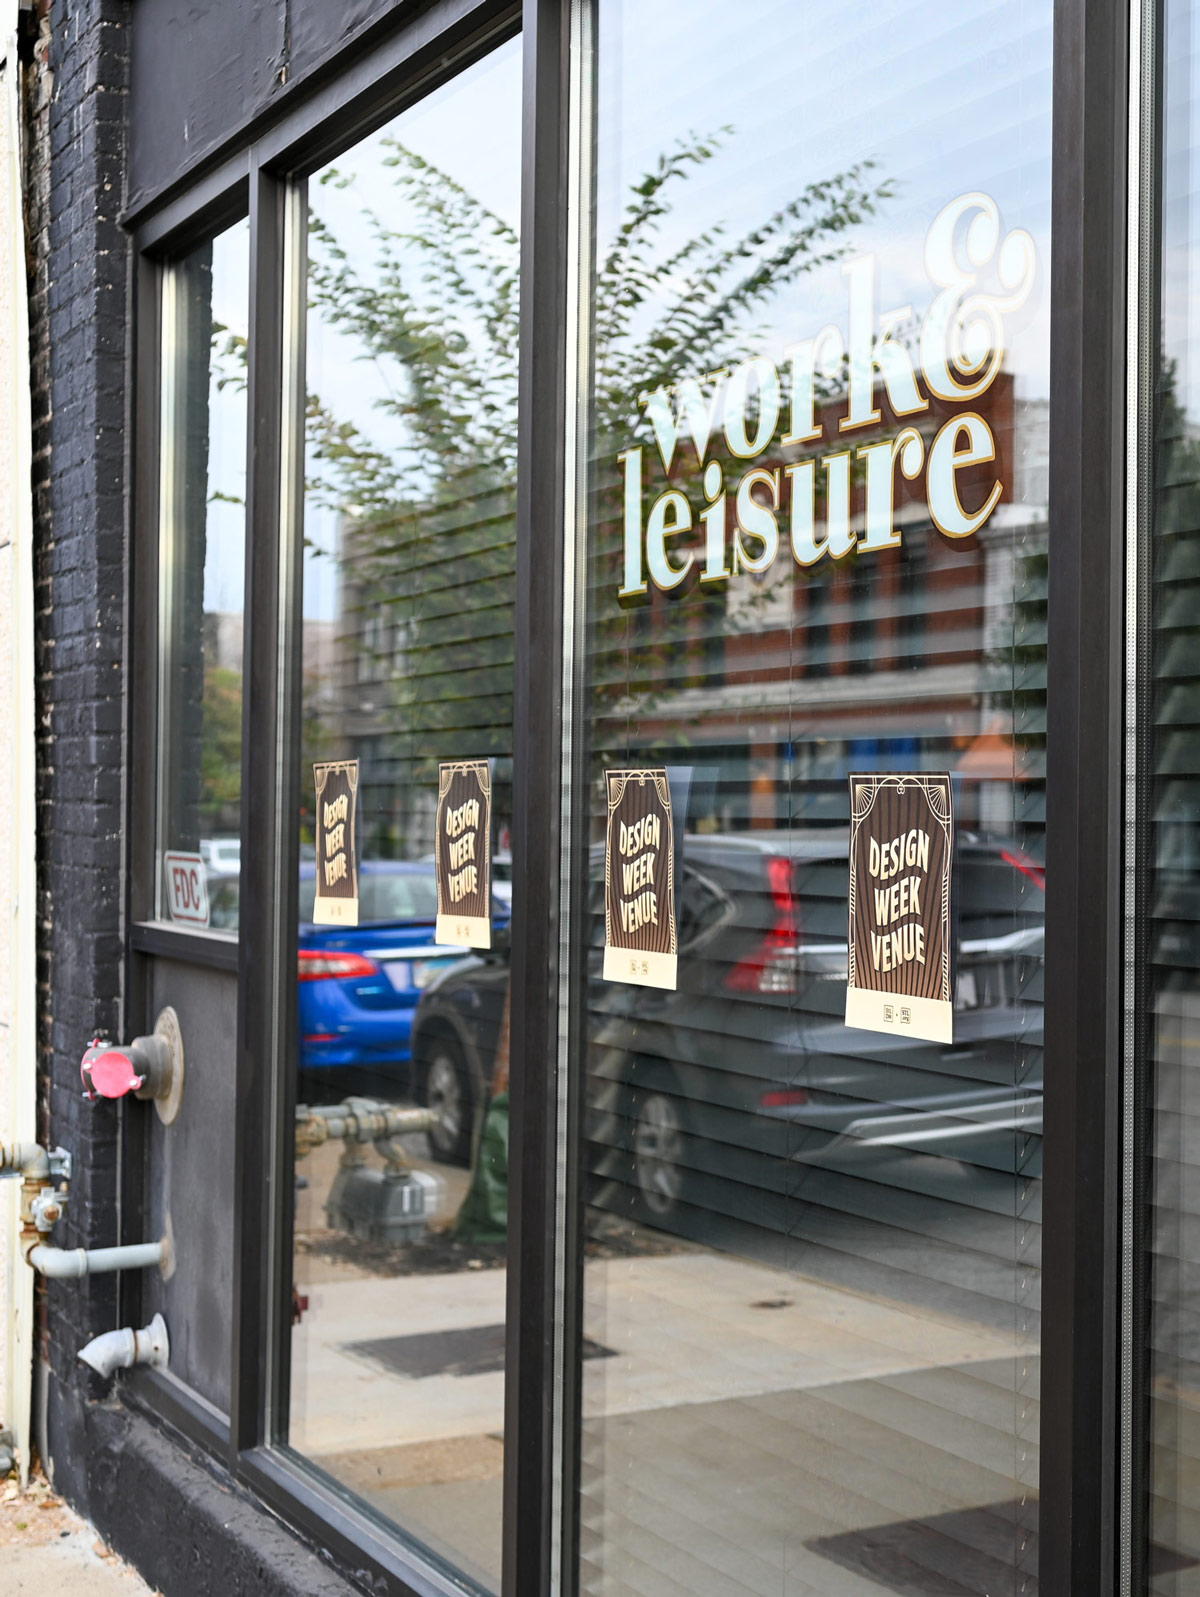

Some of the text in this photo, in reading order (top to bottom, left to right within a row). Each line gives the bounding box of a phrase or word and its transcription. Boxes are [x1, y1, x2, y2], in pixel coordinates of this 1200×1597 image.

[617, 410, 1004, 600] leisure
[323, 794, 349, 830] DESIGN
[445, 798, 480, 837] DESIGN
[448, 832, 476, 870] WEEK
[618, 813, 660, 858] DESIGN
[868, 828, 930, 881] DESIGN
[173, 867, 200, 911] FDC
[447, 865, 478, 903] VENUE
[622, 852, 655, 896] WEEK
[619, 890, 659, 934] VENUE
[873, 875, 922, 927] WEEK
[870, 922, 926, 974] VENUE
